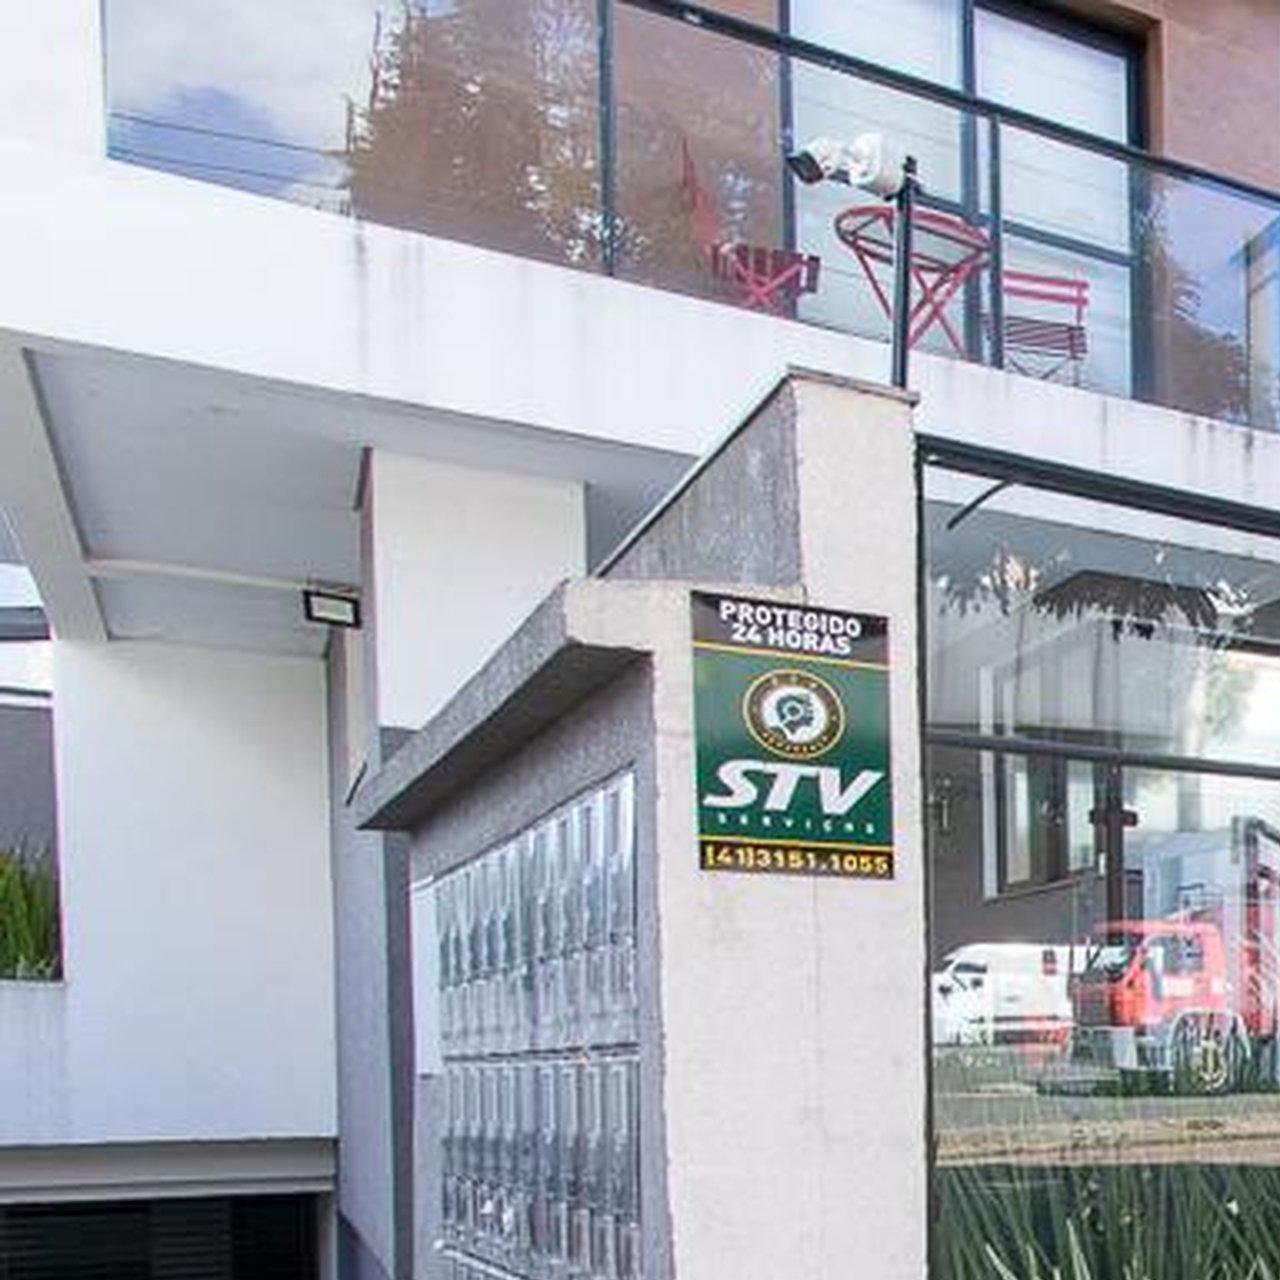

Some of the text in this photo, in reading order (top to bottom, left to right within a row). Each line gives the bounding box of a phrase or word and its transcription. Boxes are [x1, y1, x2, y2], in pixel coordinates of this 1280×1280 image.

[719, 600, 861, 637] PROTEGIDO
[731, 623, 852, 655] 24 HORAS
[702, 758, 885, 815] STV
